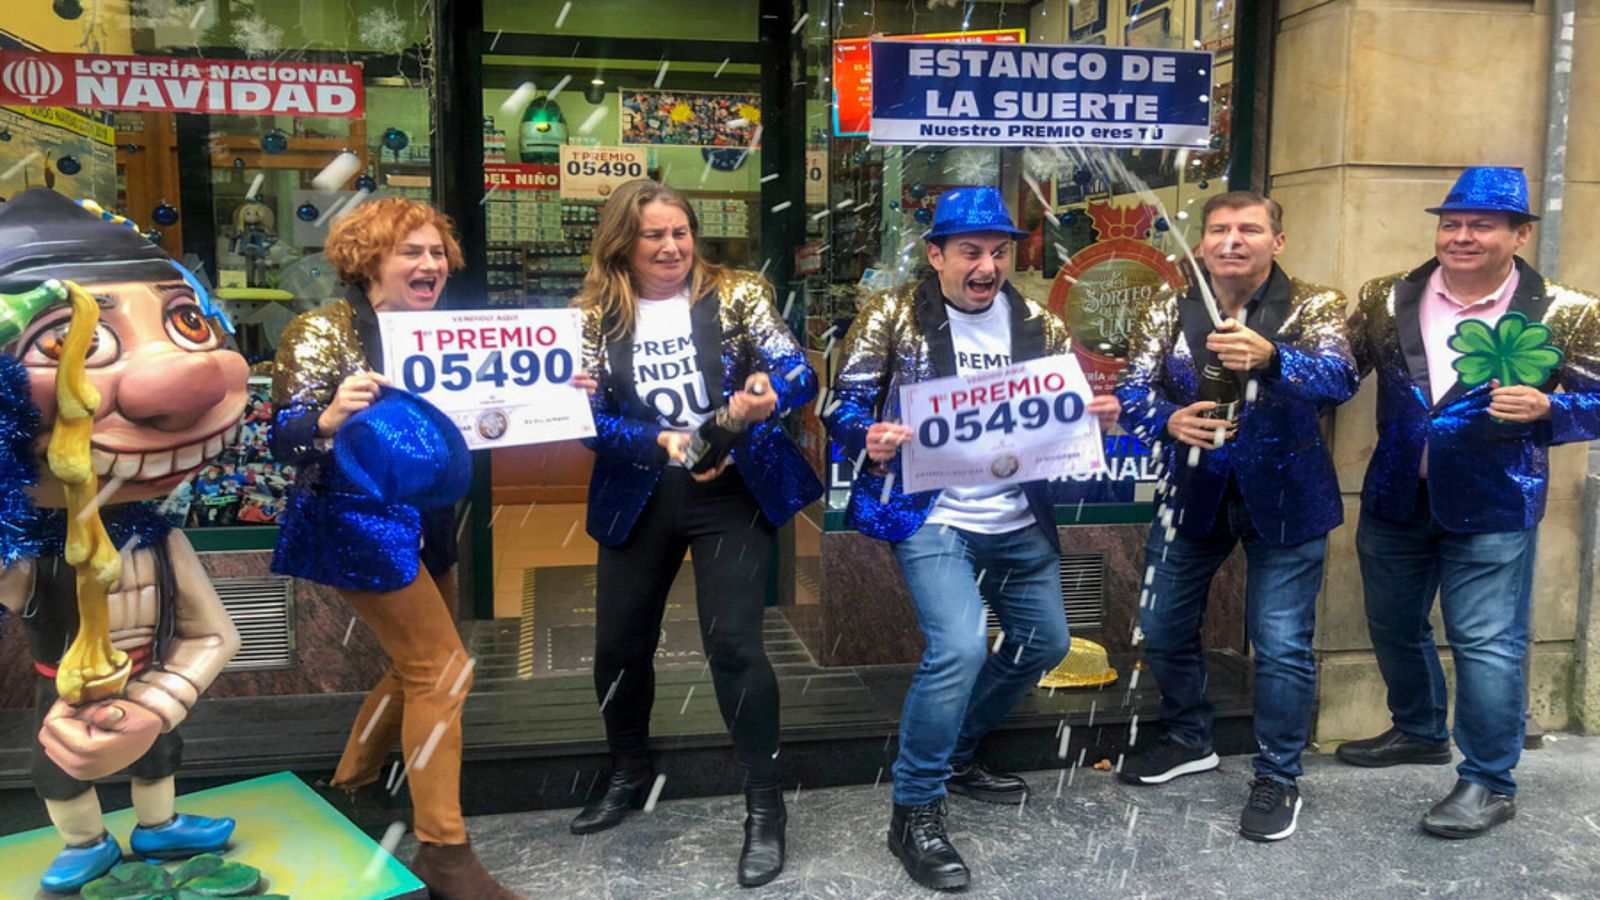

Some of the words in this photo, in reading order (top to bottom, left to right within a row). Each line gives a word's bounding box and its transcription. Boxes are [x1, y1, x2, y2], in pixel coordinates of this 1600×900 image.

[75, 59, 200, 79] LOTERÍA
[210, 64, 353, 84] NACIONAL
[908, 49, 1107, 82] ESTANCO
[1121, 54, 1176, 83] DE
[75, 76, 356, 114] NAVIDAD
[926, 90, 981, 118] LA
[994, 91, 1158, 121] SUERTE
[920, 123, 1001, 137] Nuestro
[1008, 124, 1085, 138] PREMIO
[1091, 127, 1133, 139] eres
[1139, 125, 1164, 140] TÚ
[567, 160, 642, 177] 05490
[583, 151, 635, 162] PREMIO
[515, 171, 559, 186] NIÑO
[437, 326, 557, 351] PREMIO
[402, 348, 573, 394] 05490
[635, 355, 697, 383] NDI
[956, 351, 1010, 370] REMI
[951, 372, 1066, 411] PREMIO
[918, 391, 1085, 448] 05490
[1048, 456, 1159, 482] NAL
